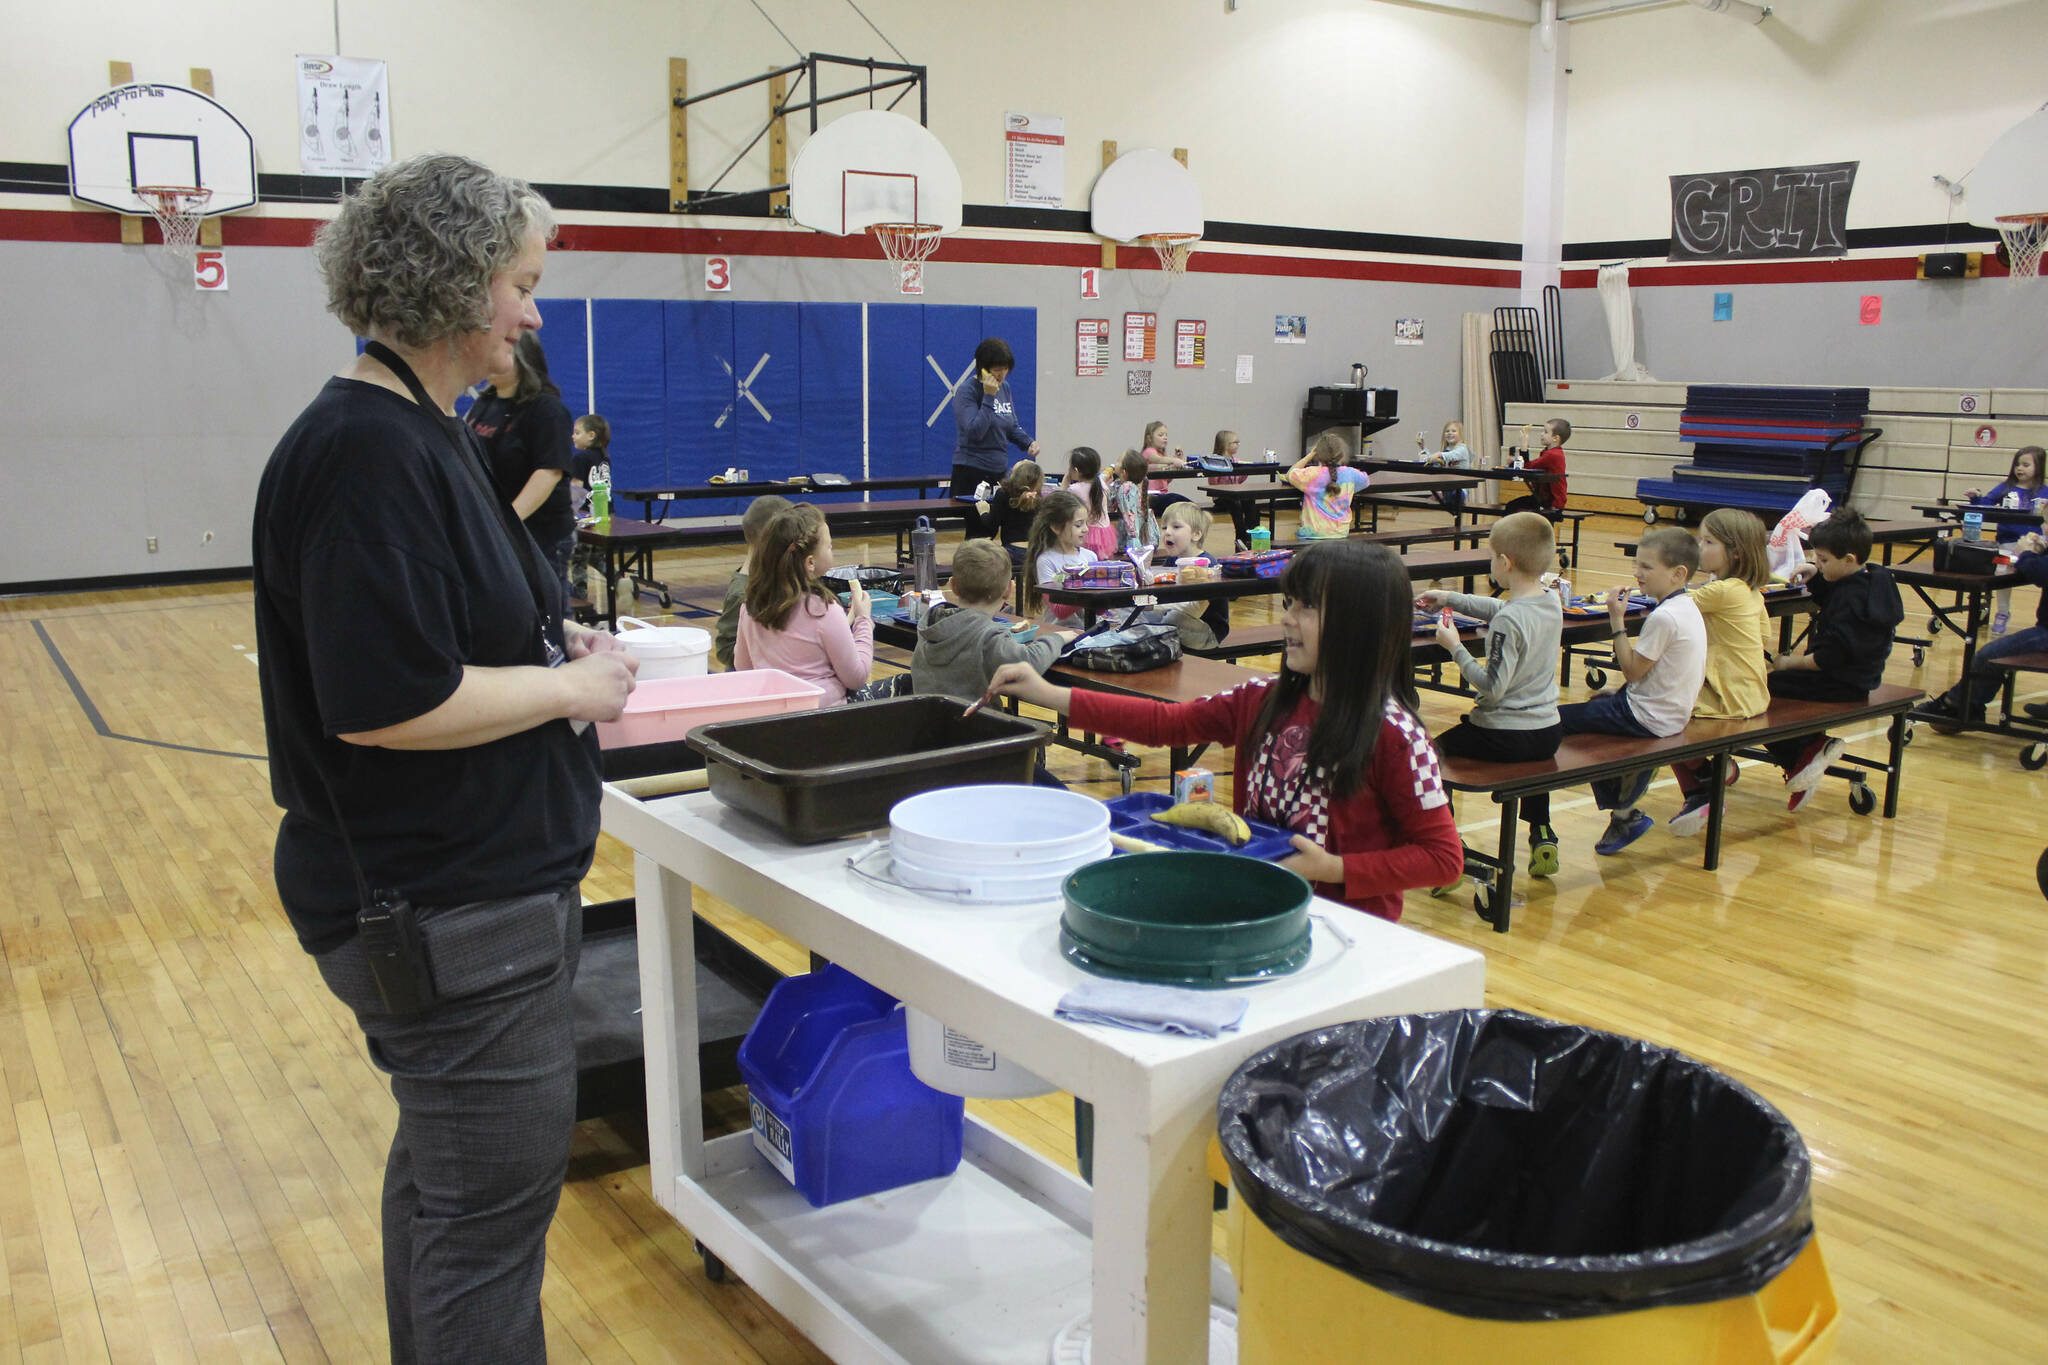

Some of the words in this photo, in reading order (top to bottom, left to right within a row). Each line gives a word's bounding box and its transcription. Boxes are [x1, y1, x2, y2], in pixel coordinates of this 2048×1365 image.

[139, 84, 165, 98] Plus
[1674, 168, 1851, 254] GRIT
[196, 252, 224, 288] 5
[706, 258, 730, 289] 3
[902, 262, 922, 293] 2
[1082, 269, 1098, 297] 1
[1861, 296, 1880, 324] G
